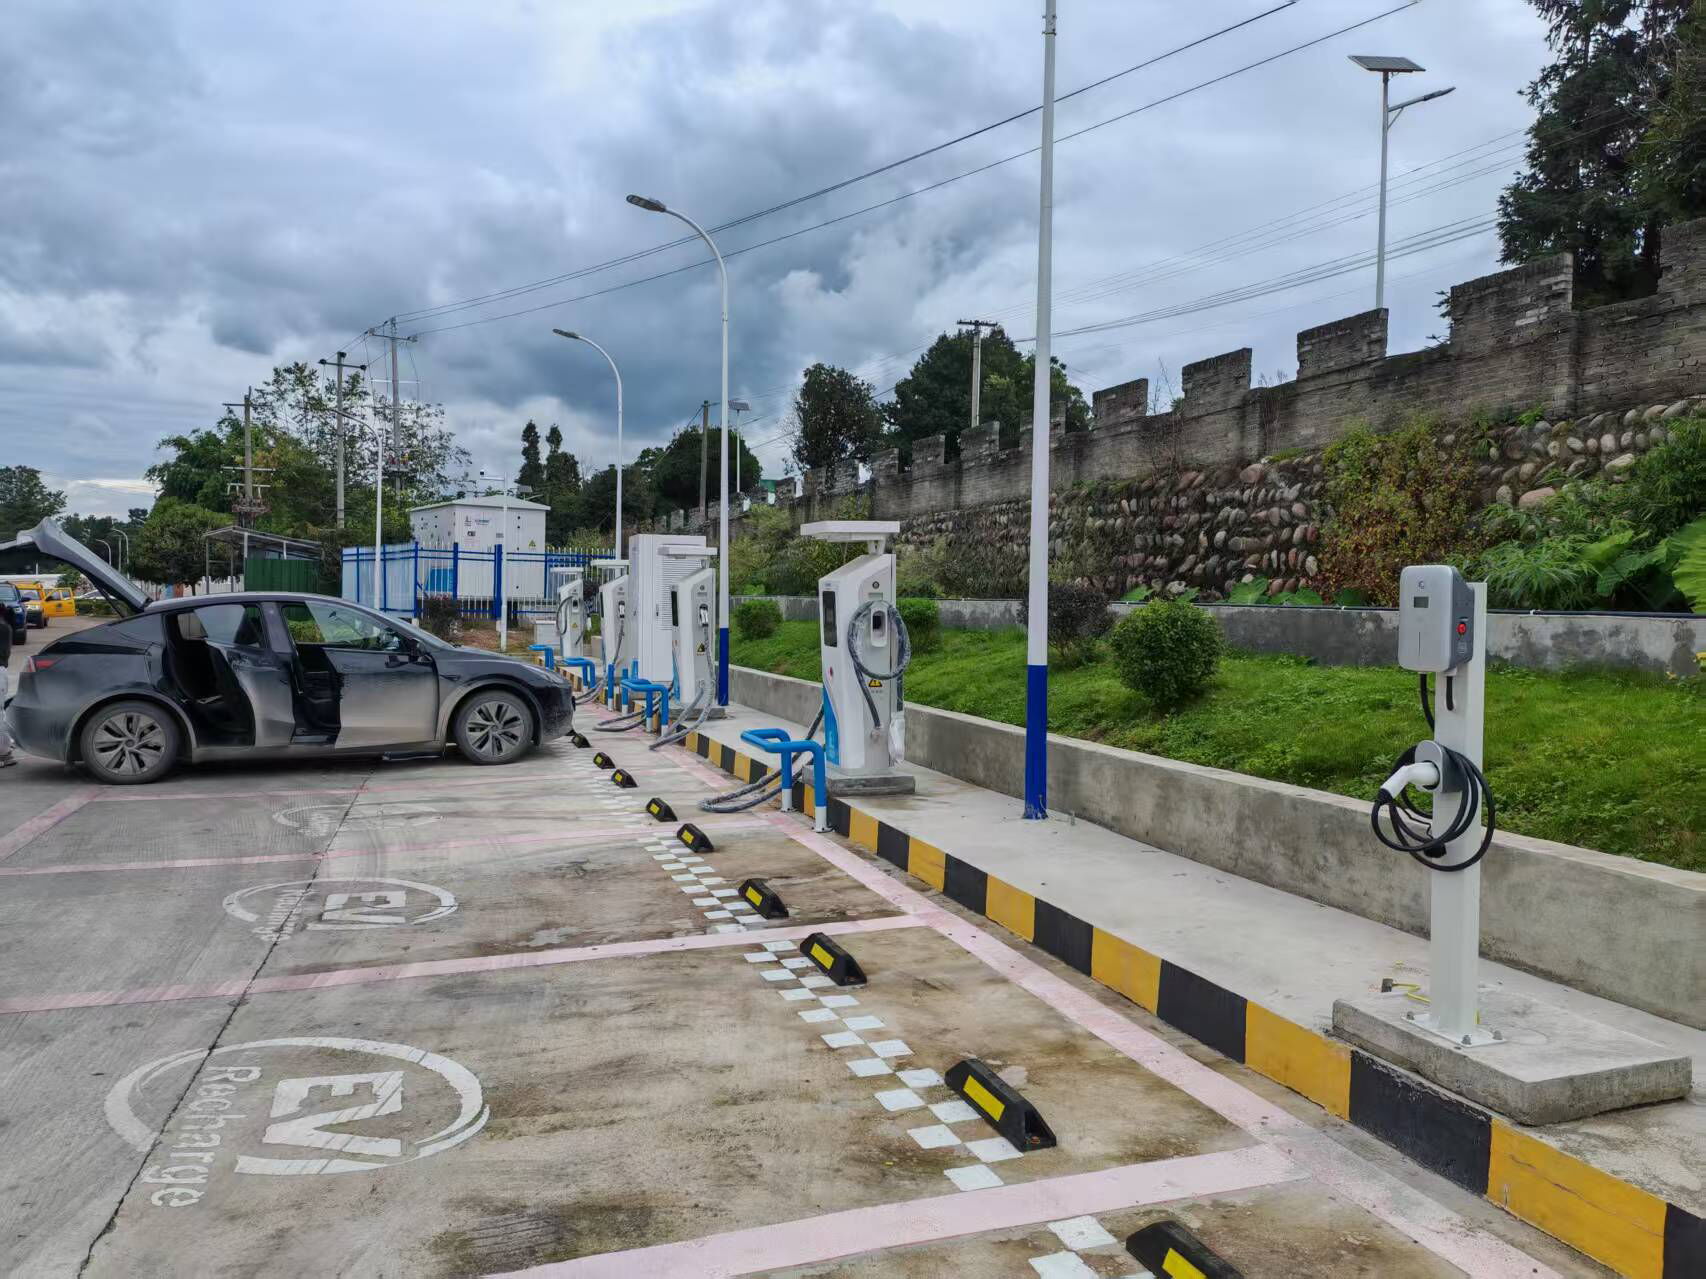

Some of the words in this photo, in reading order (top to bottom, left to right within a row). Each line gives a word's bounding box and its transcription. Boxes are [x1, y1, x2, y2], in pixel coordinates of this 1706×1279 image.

[322, 890, 407, 924] EV
[141, 1066, 262, 1208] Recharge
[262, 1071, 404, 1157] EV
